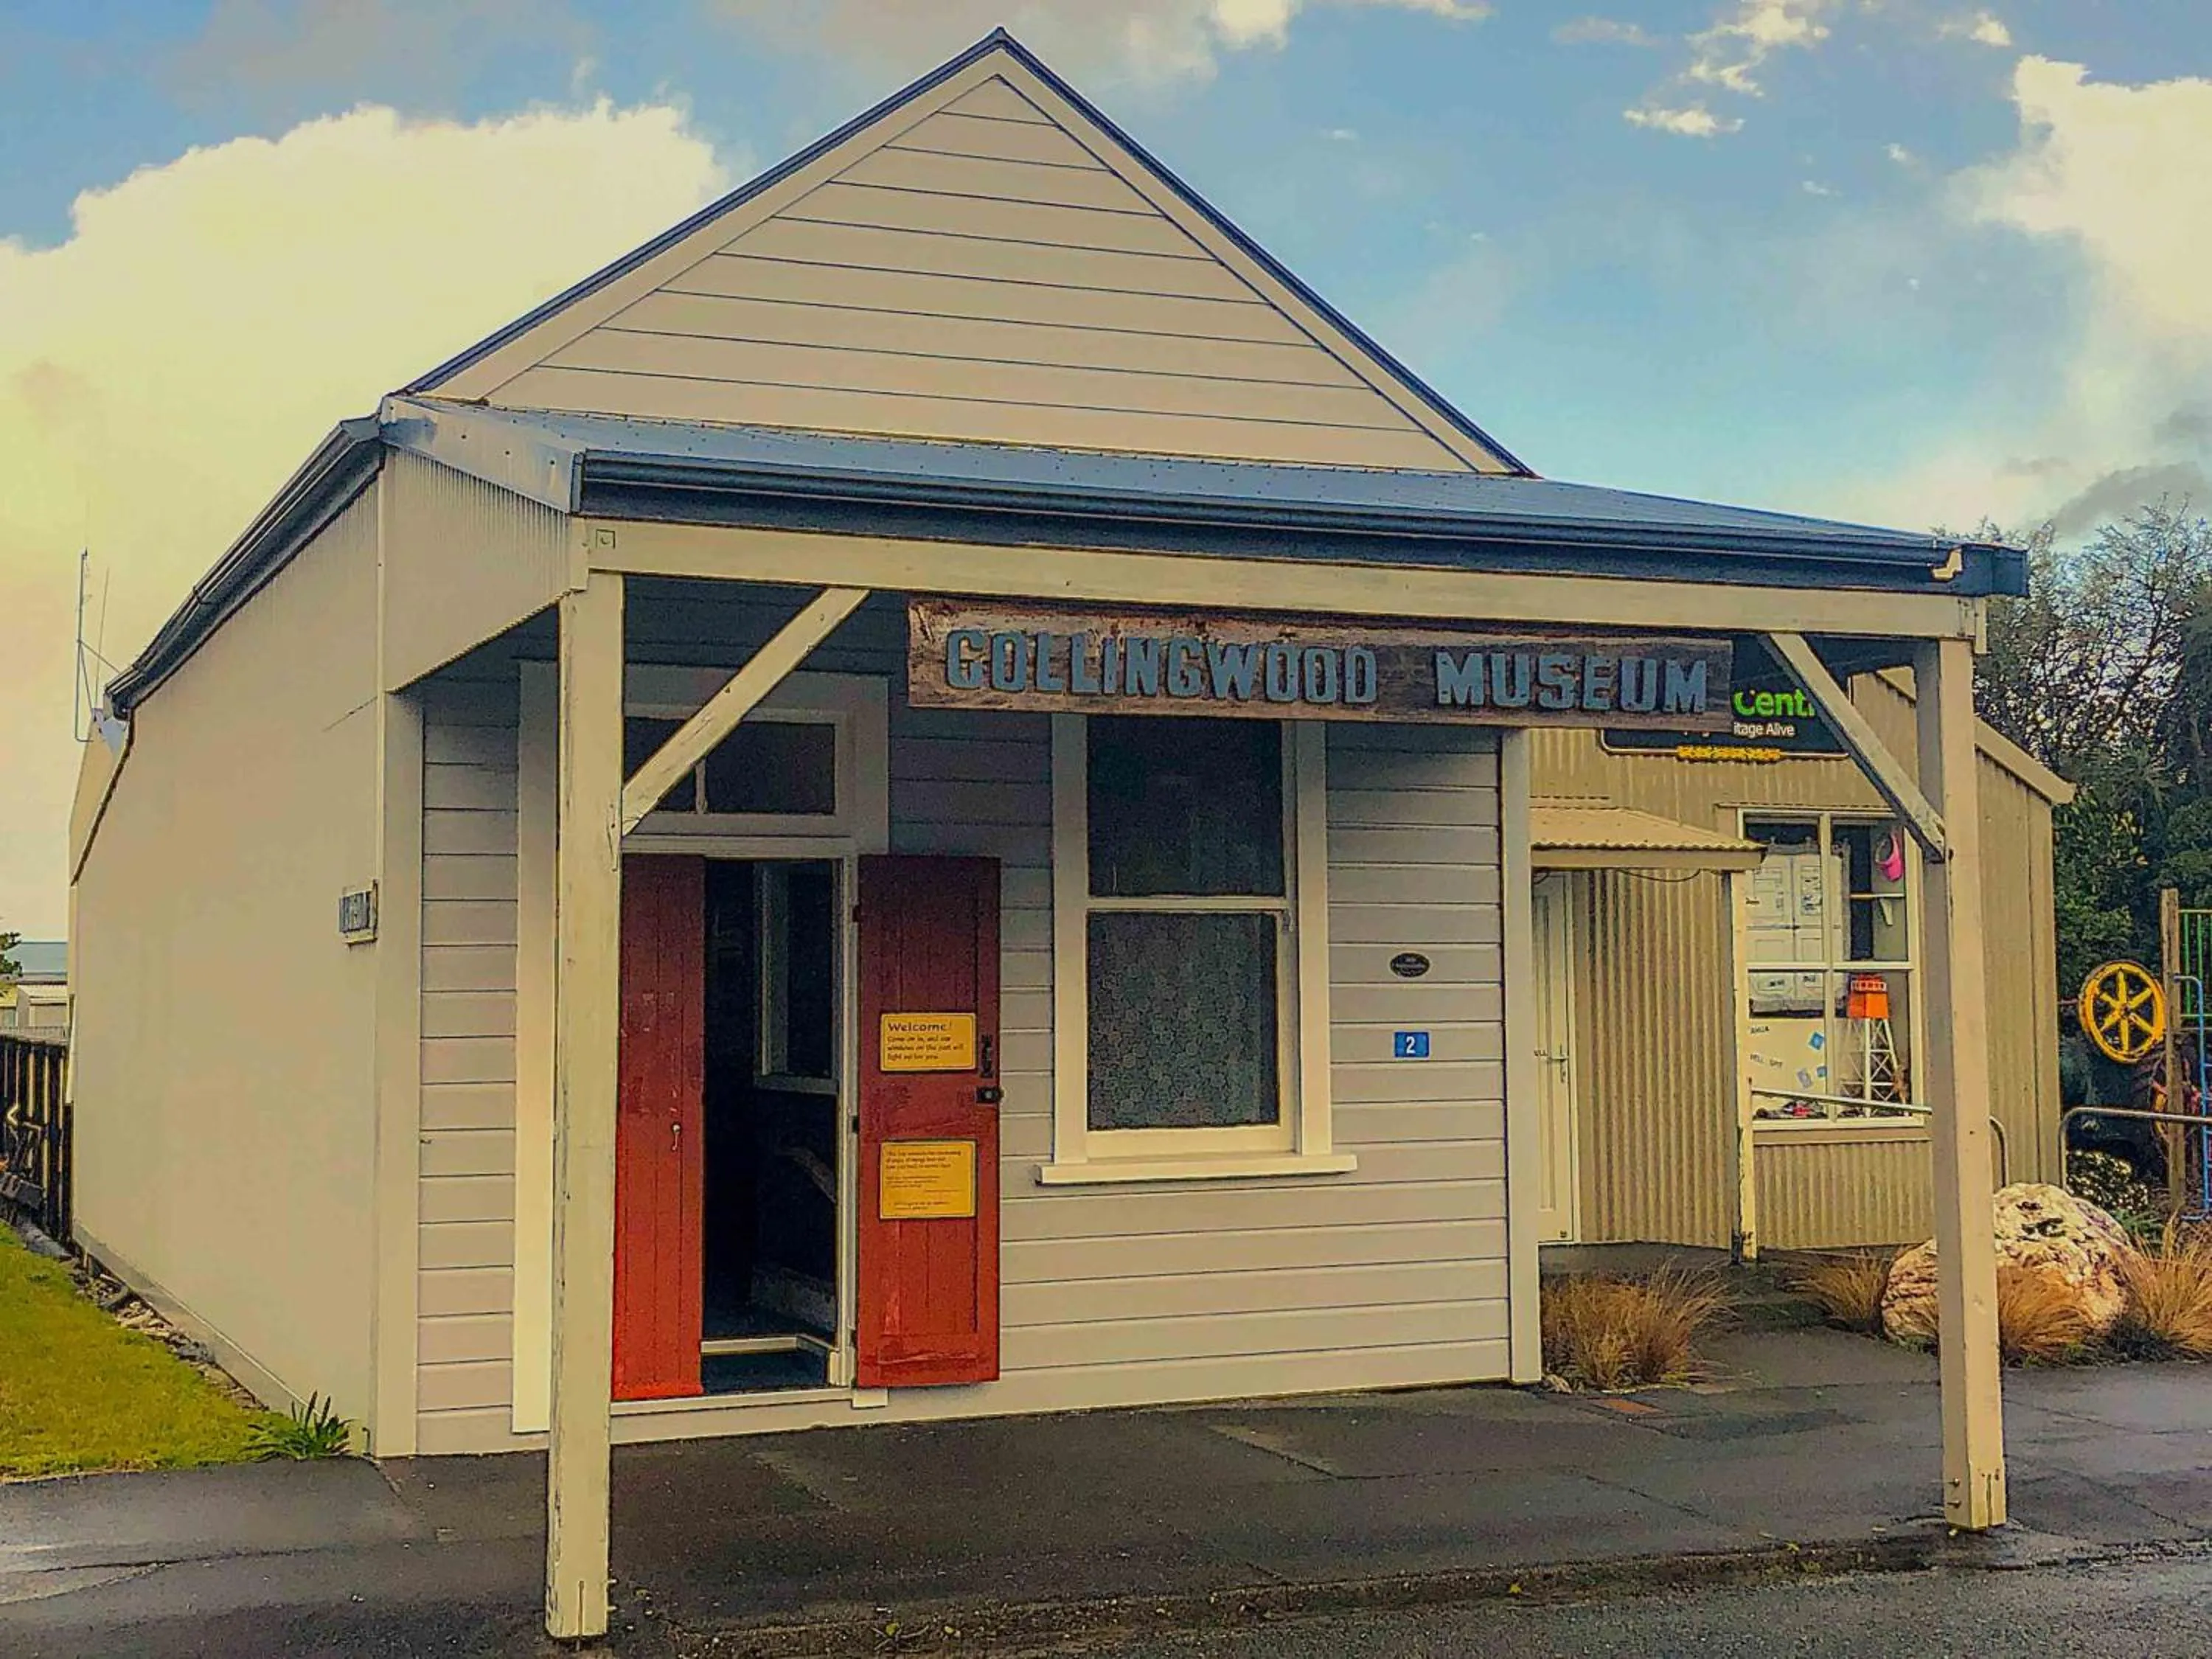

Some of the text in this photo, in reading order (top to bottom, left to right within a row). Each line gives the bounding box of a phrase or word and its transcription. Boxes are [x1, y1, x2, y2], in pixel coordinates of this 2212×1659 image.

[946, 629, 1707, 713] COLLINGWOOD MUSEUM
[1733, 722, 1795, 738] itage Alive
[1405, 1036, 1416, 1054] 2
